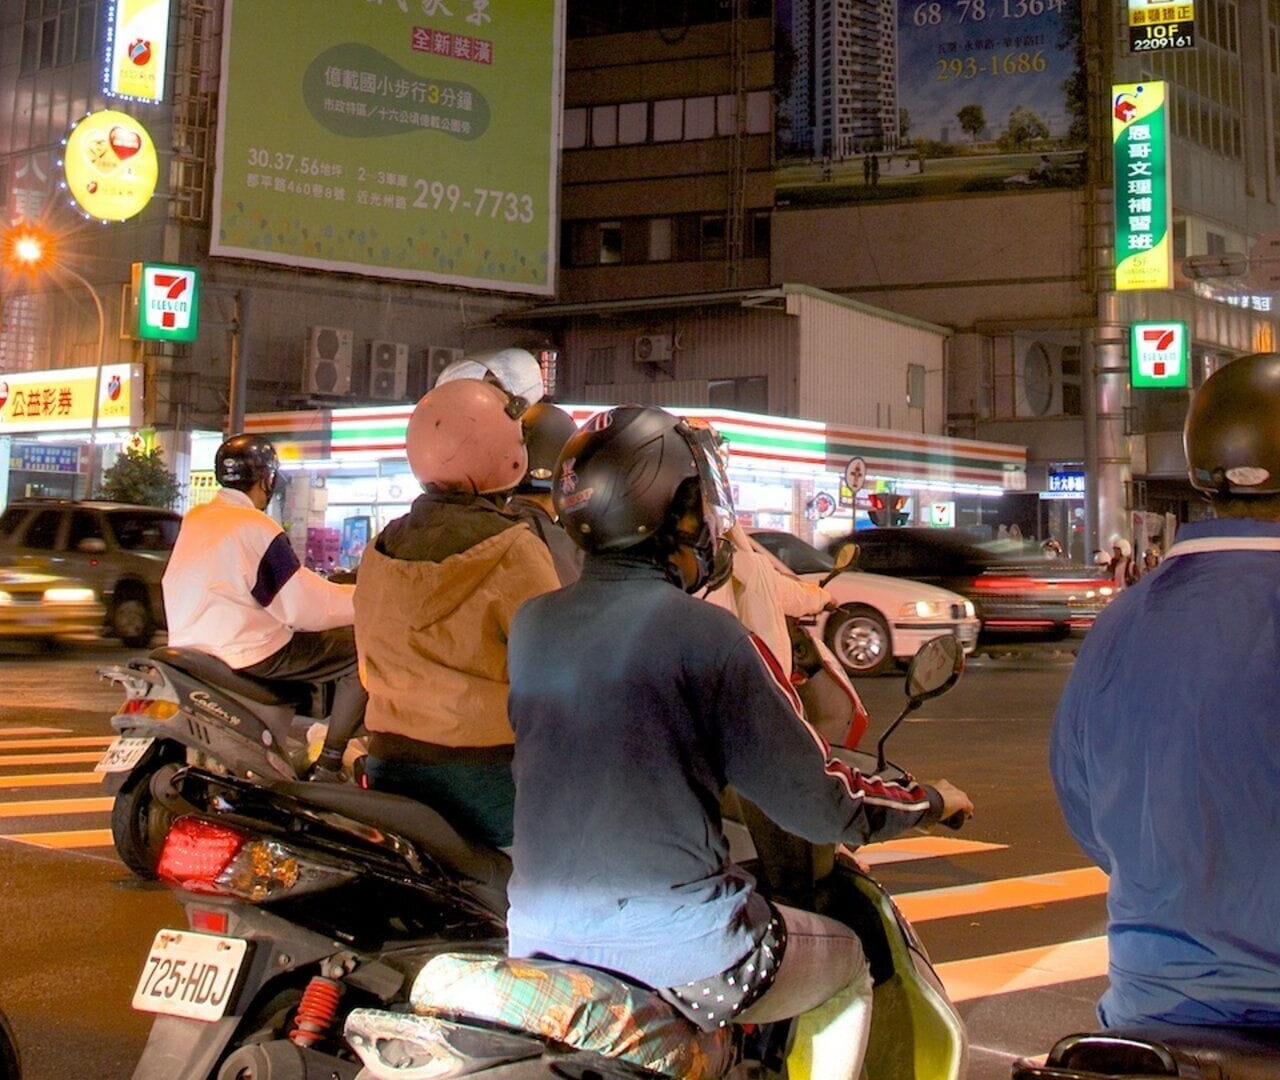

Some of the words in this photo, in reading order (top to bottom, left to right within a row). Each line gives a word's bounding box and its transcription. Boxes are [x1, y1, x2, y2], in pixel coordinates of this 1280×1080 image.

[1134, 35, 1191, 50] 2209161
[1146, 24, 1179, 39] 10F
[936, 52, 1046, 81] 293-1686
[413, 178, 534, 223] 299-7733
[11, 388, 73, 417] 公益彩券
[141, 957, 234, 1007] 725-HDJ
